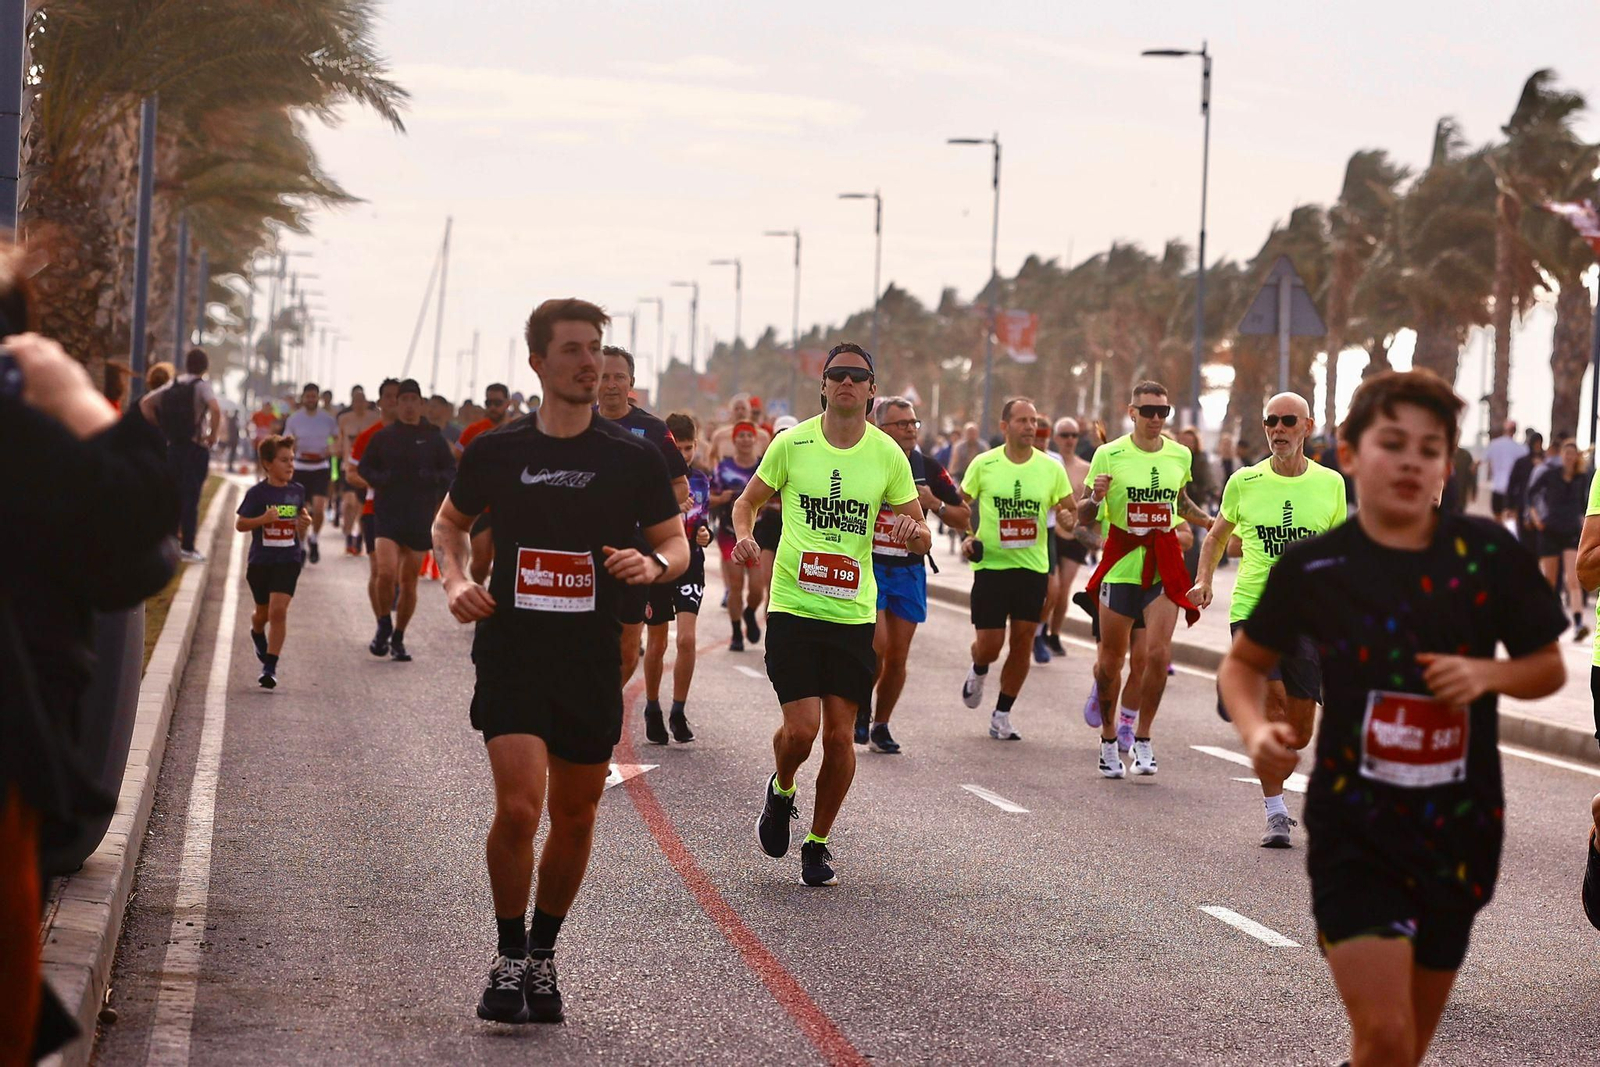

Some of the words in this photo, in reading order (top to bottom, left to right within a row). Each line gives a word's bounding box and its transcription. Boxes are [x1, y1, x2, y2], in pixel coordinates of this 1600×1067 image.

[533, 468, 596, 488] NIKE
[1126, 487, 1178, 502] BRUNCH
[799, 493, 869, 519] BRUNCH
[993, 496, 1040, 512] BRUNCH
[806, 510, 841, 530] RUN
[1151, 513, 1167, 523] 564
[840, 521, 867, 536] 2025
[557, 573, 592, 588] 1035
[833, 569, 854, 581] 198
